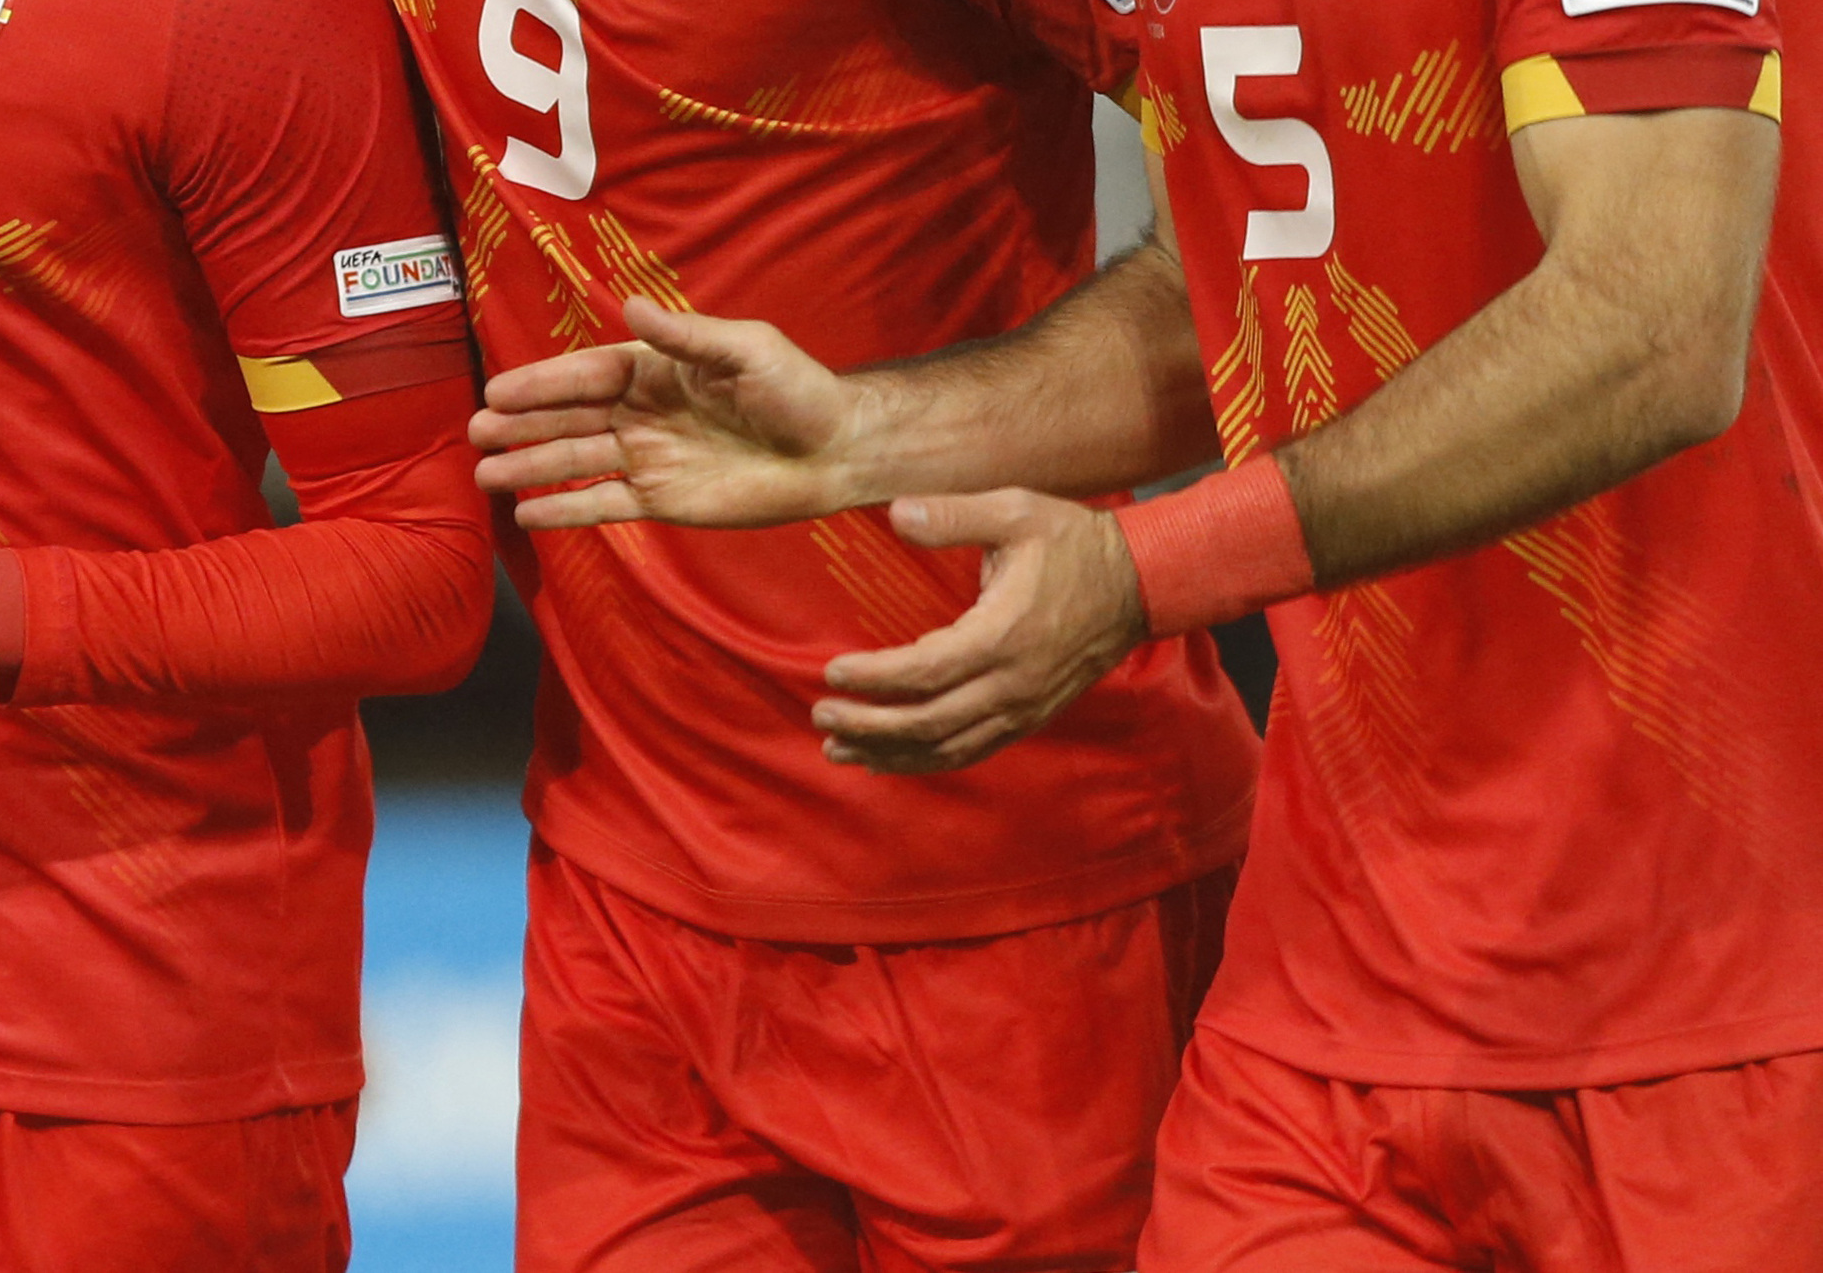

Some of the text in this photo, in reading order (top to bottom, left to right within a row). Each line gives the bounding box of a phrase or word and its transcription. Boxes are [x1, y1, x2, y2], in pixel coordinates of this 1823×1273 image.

[1199, 24, 1336, 262] 5
[340, 249, 382, 269] UEFA
[343, 253, 451, 294] FOUNDAT
